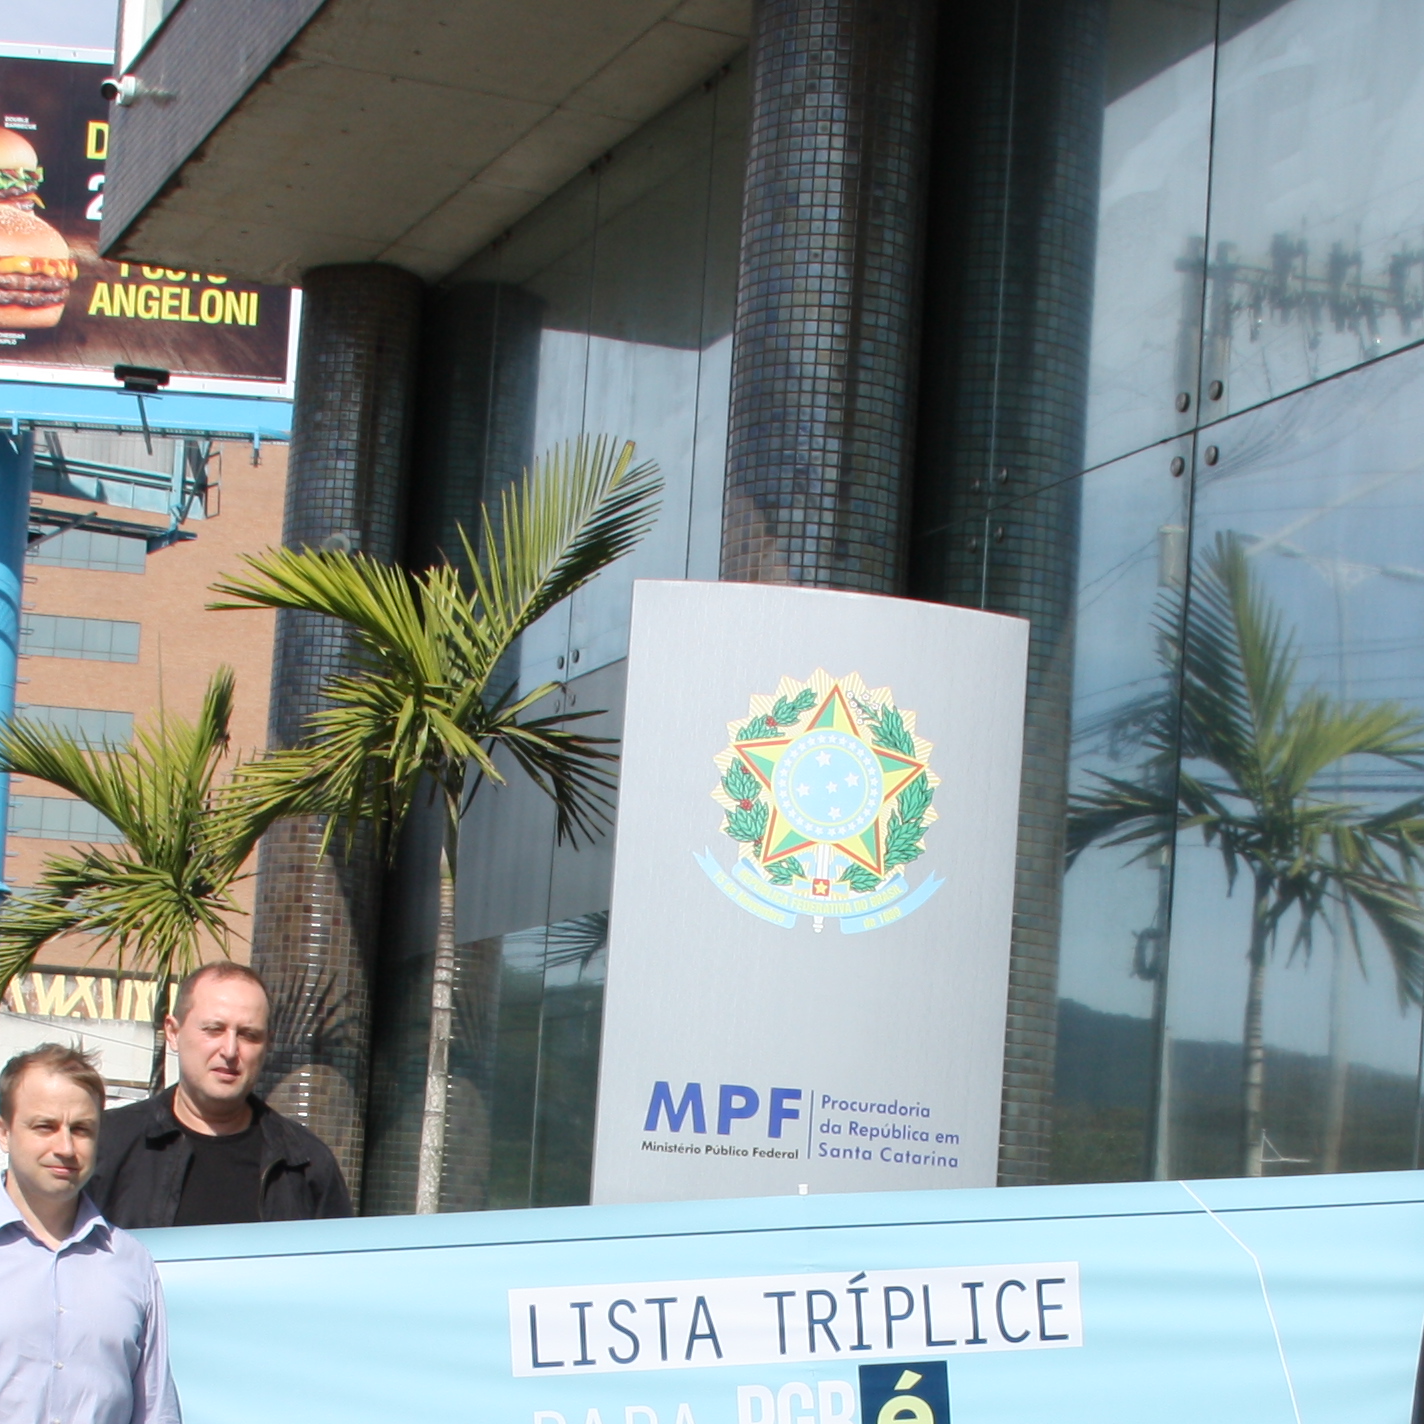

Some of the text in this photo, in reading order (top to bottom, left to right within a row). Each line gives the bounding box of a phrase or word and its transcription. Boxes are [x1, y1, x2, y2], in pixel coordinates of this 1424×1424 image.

[88, 281, 258, 326] ANGELONI
[643, 1081, 802, 1139] MPF
[821, 1094, 931, 1118] Procuradoria
[819, 1119, 960, 1145] da República em
[641, 1140, 799, 1160] Ministério Público Federal
[818, 1142, 959, 1168] Santa Catarina
[528, 1270, 1070, 1370] LISTA TRÍPLICE
